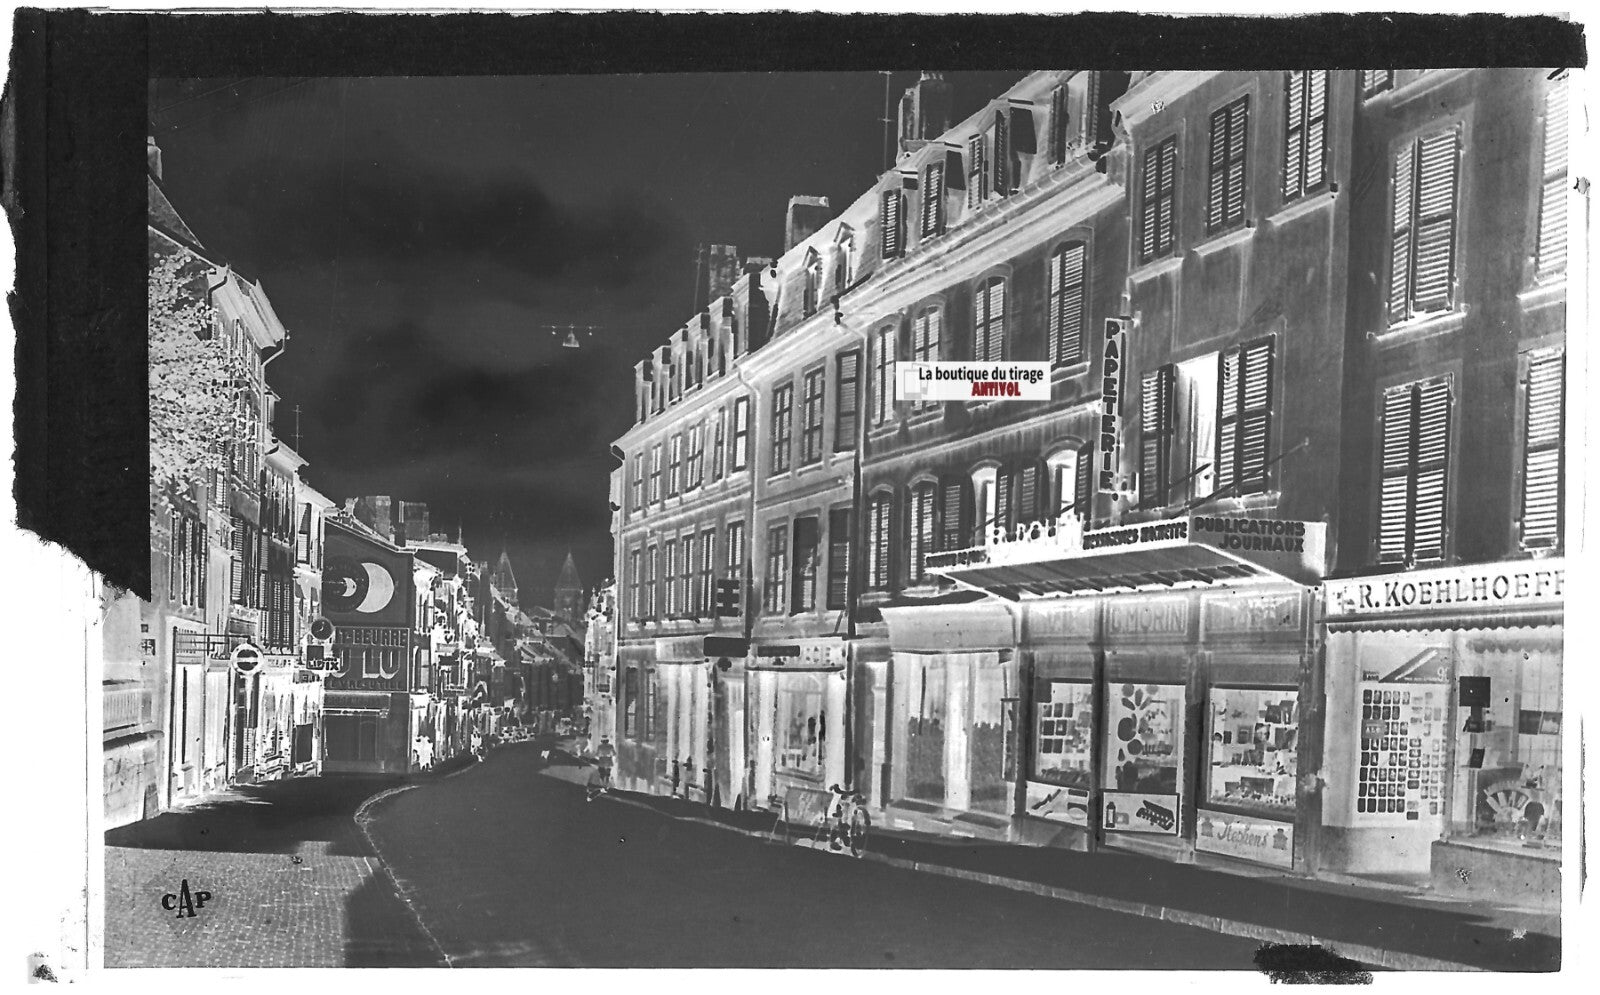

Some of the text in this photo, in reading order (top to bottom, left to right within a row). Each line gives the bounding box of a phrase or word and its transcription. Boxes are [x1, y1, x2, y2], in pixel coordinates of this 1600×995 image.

[1099, 320, 1121, 490] PAPETERIE
[1194, 516, 1306, 536] PUBLICATIONS
[1219, 533, 1305, 553] JOURNAUX
[1360, 583, 1380, 609] R.
